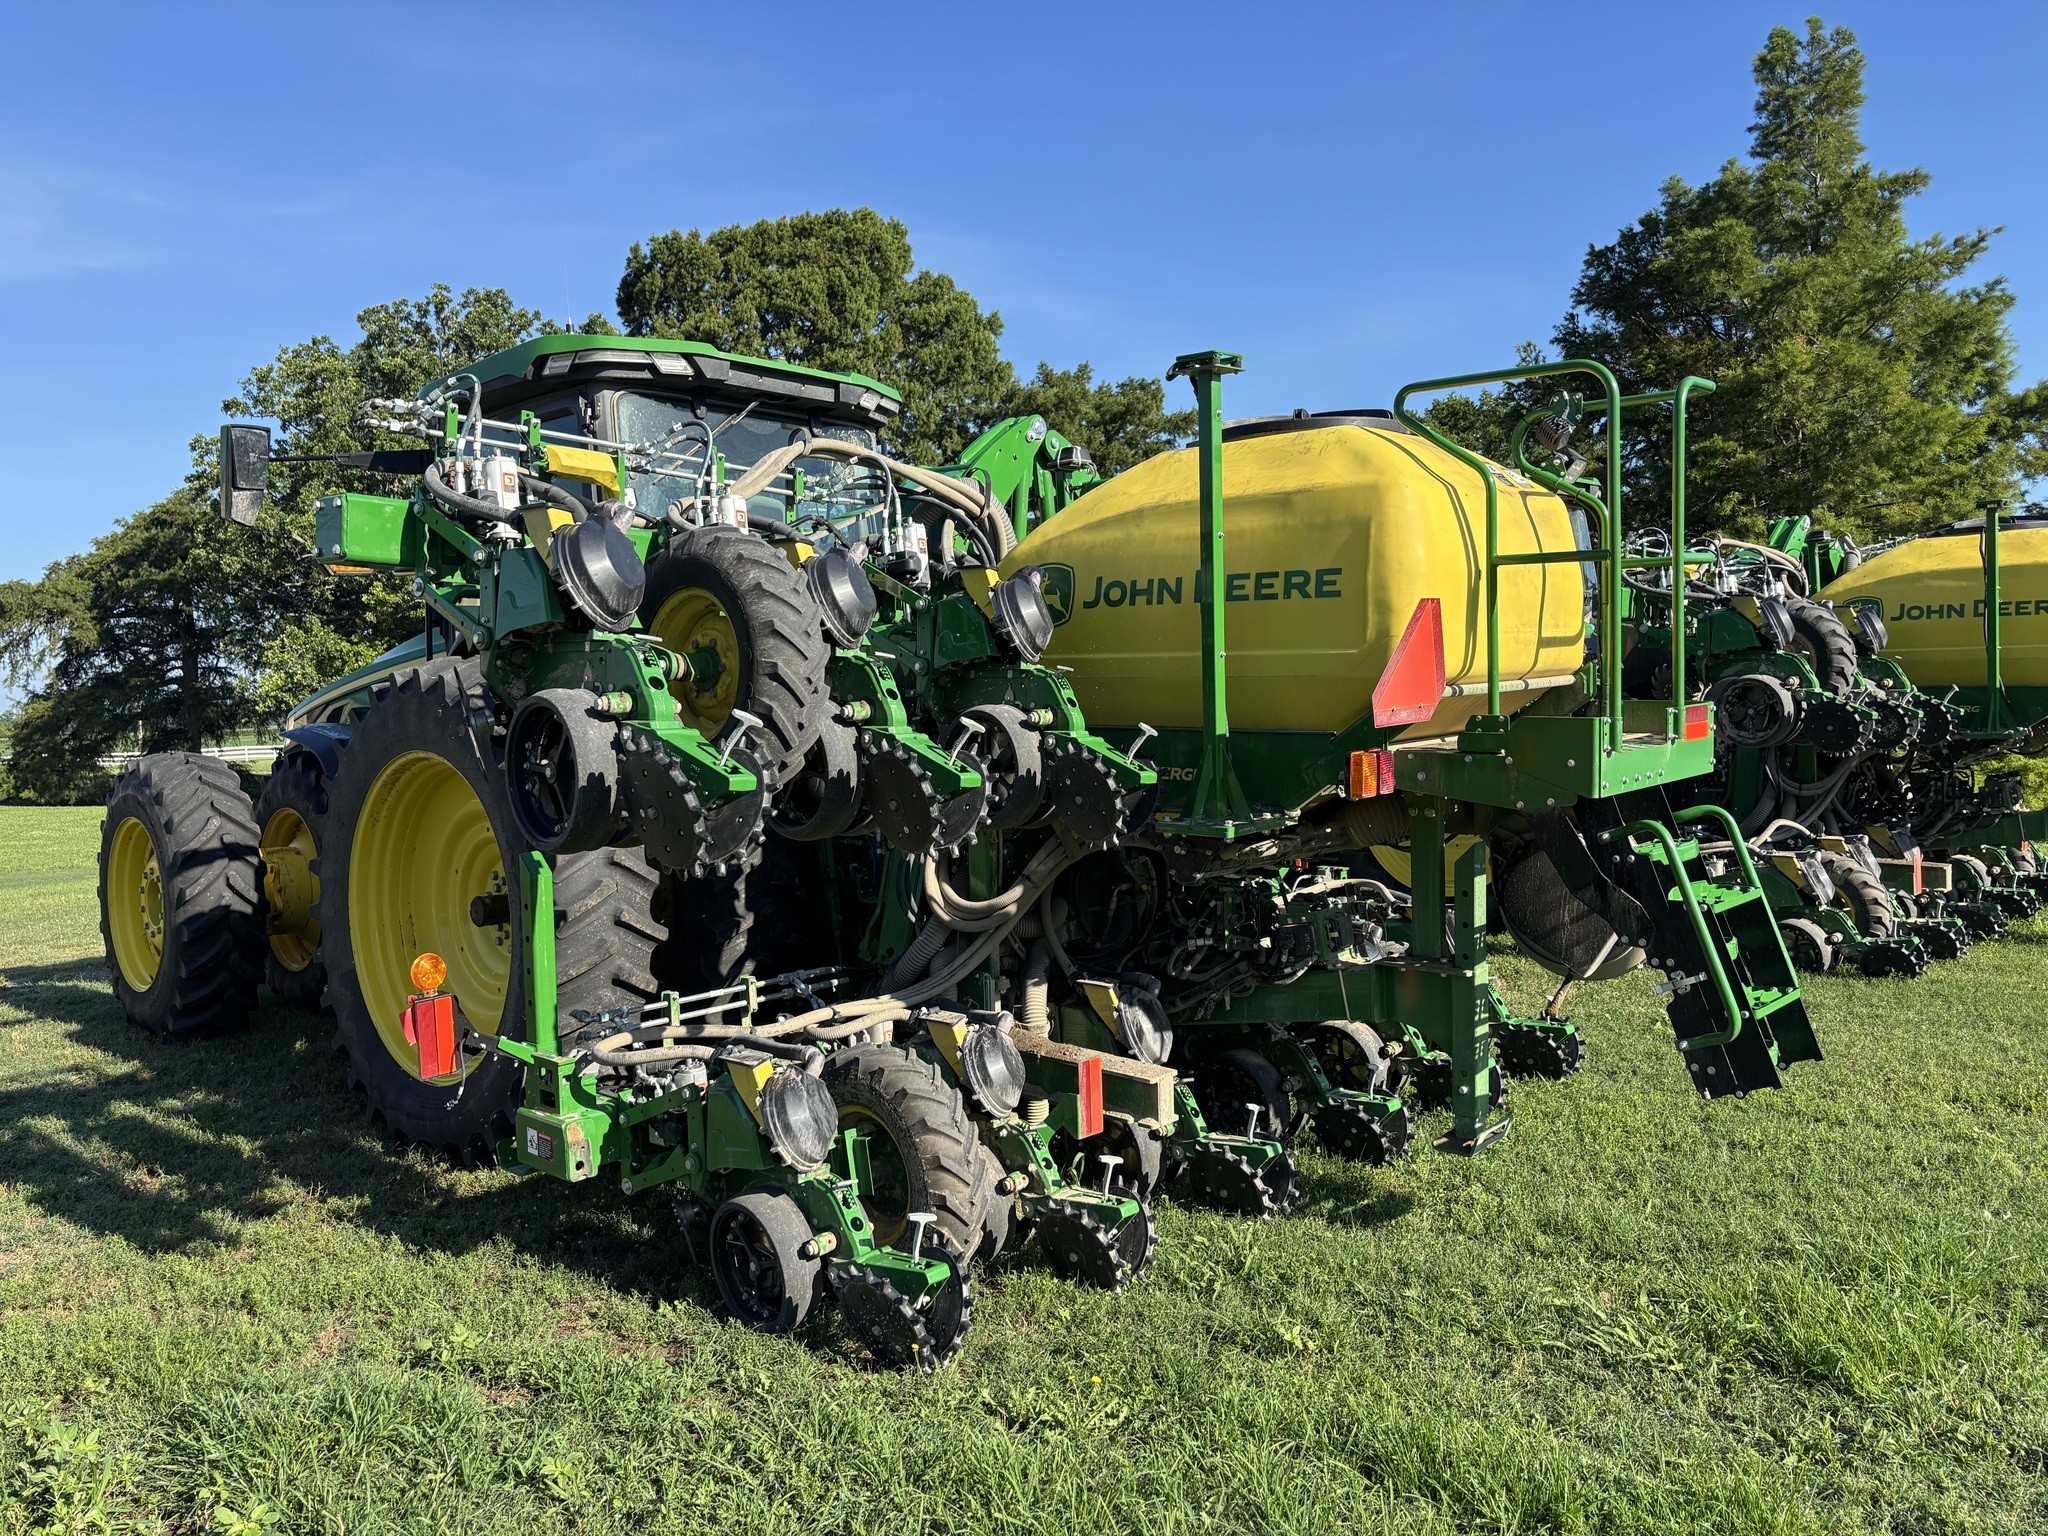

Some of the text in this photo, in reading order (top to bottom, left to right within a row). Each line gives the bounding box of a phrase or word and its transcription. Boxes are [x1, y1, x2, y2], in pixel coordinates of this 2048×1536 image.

[1083, 568, 1342, 609] JOHN EERE
[1891, 603, 1965, 621] JOHN
